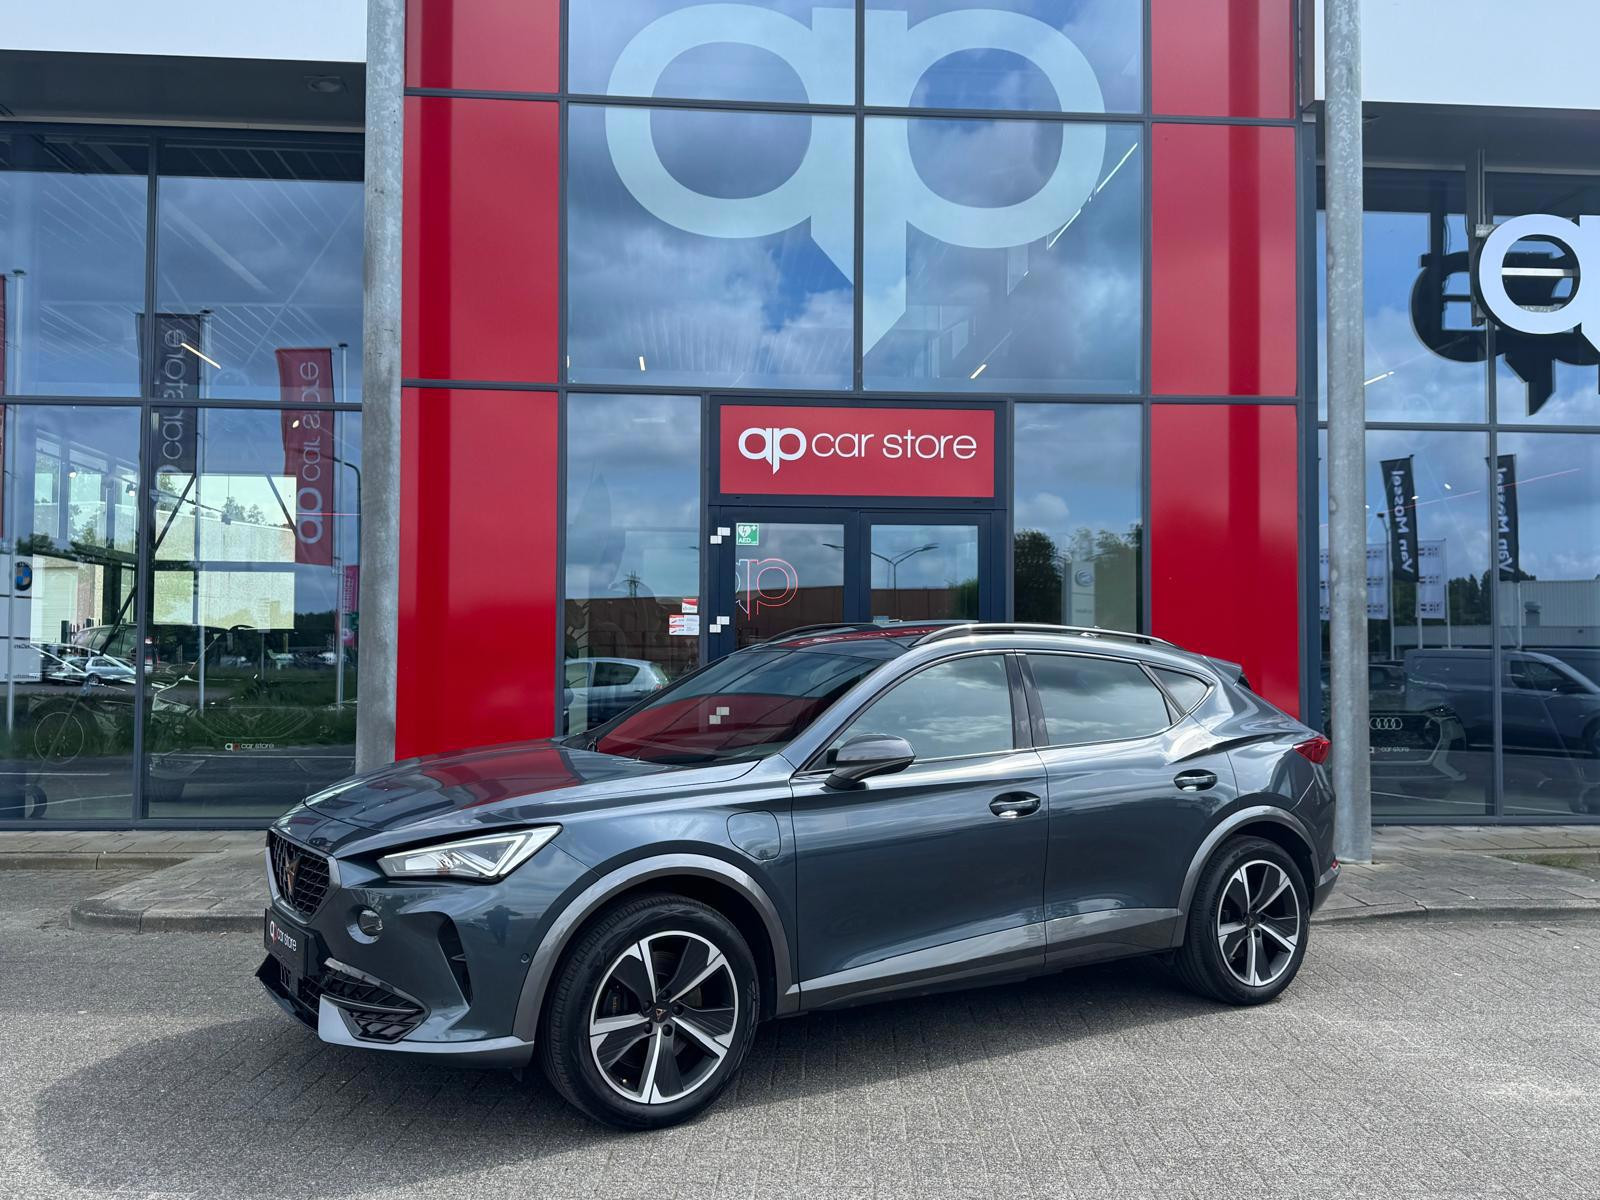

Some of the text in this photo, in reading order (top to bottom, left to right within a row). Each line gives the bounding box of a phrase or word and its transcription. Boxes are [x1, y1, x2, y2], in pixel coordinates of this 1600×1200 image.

[605, 3, 1107, 357] ap
[738, 427, 977, 475] ap car store
[284, 933, 297, 951] store
